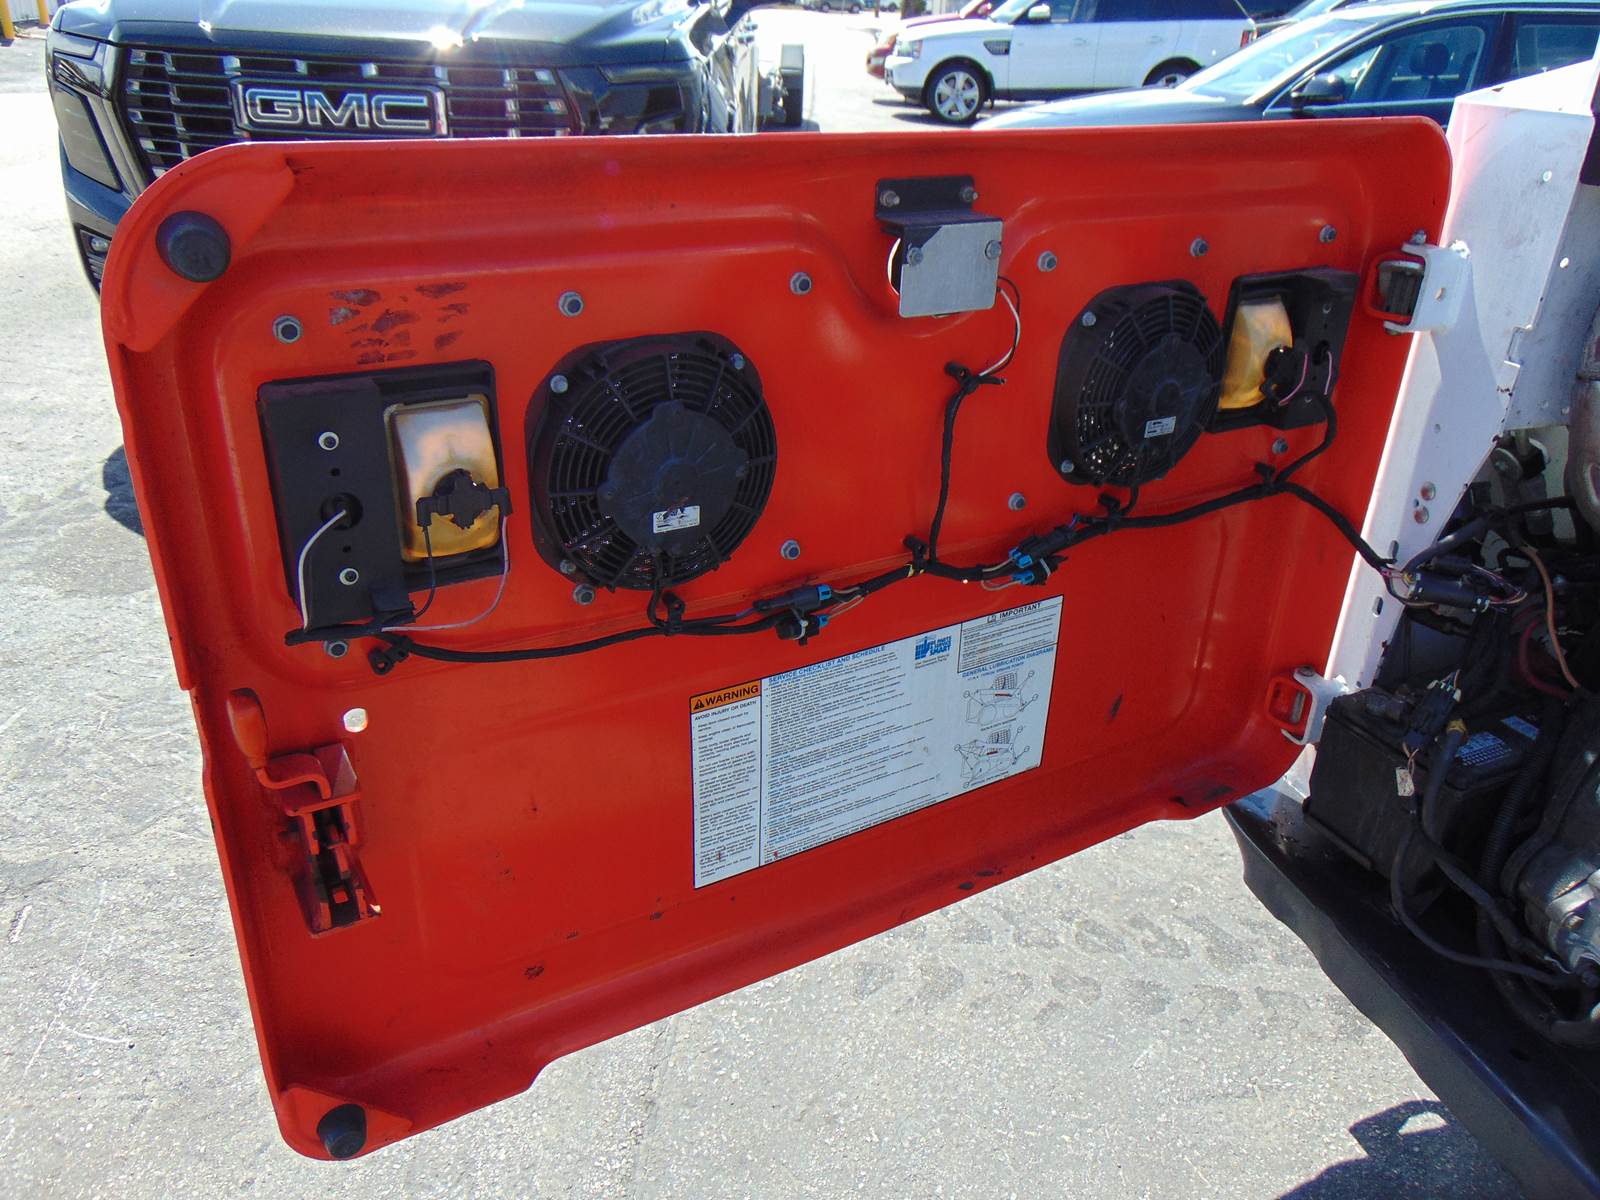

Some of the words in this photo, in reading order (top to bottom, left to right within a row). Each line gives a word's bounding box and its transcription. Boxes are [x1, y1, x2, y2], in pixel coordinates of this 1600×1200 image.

[246, 88, 430, 129] GMC
[999, 603, 1041, 619] IMPORTANT
[768, 670, 797, 683] SERVICE
[798, 660, 836, 675] CHECKLIST
[837, 656, 850, 664] AND
[852, 646, 885, 661] SCHEDULE
[962, 666, 988, 678] GENERAL
[989, 655, 1025, 670] LUBRICATION
[705, 685, 759, 706] WARNING
[694, 712, 711, 721] AVOID
[711, 707, 730, 717] INJURY
[740, 700, 757, 709] DEATH
